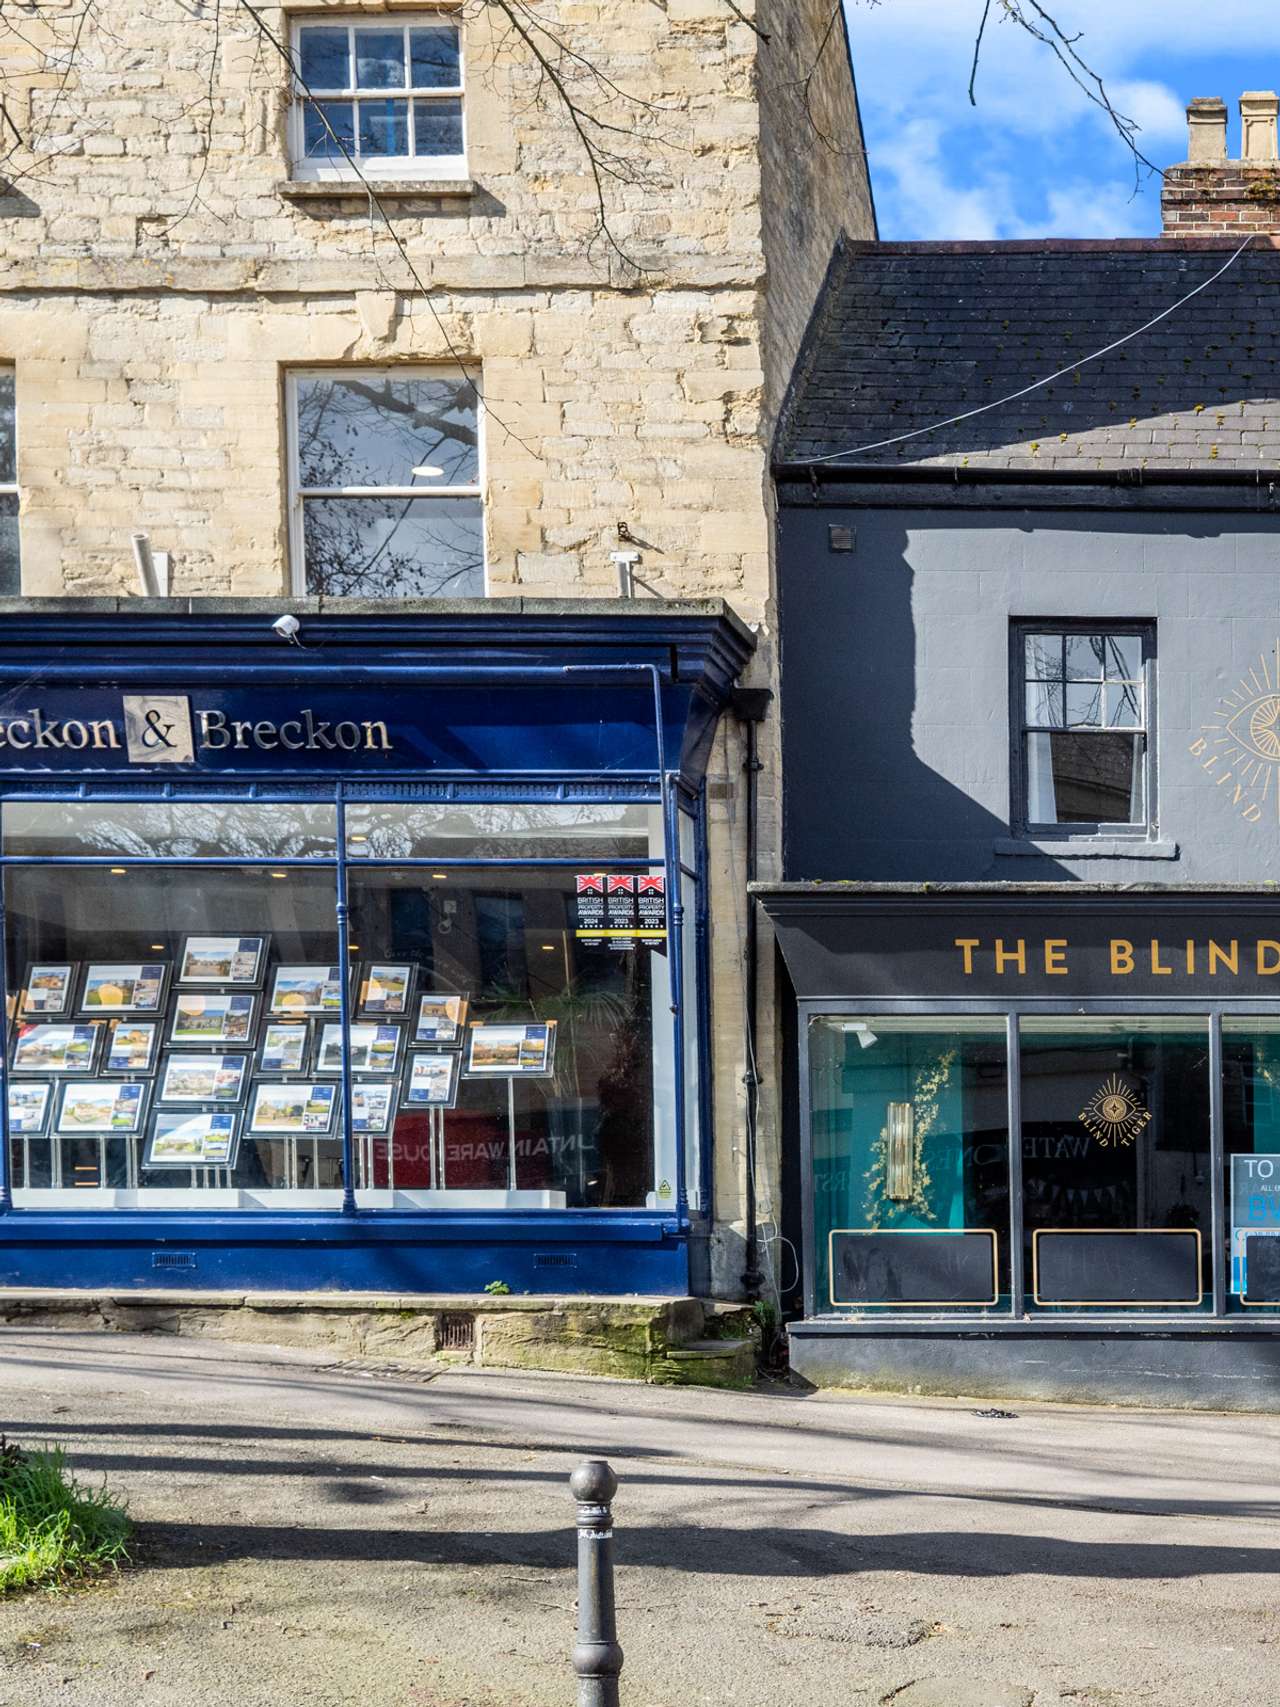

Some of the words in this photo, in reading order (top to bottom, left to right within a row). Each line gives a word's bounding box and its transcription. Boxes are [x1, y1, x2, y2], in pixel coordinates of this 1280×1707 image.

[0, 708, 122, 750] ckon
[141, 709, 177, 749] &
[195, 708, 394, 750] Breckon
[1189, 737, 1262, 823] BLIND
[955, 939, 1068, 974] THE
[1078, 1112, 1109, 1147] BLIND
[1121, 1111, 1153, 1147] TIGER
[1244, 1159, 1274, 1179] TO
